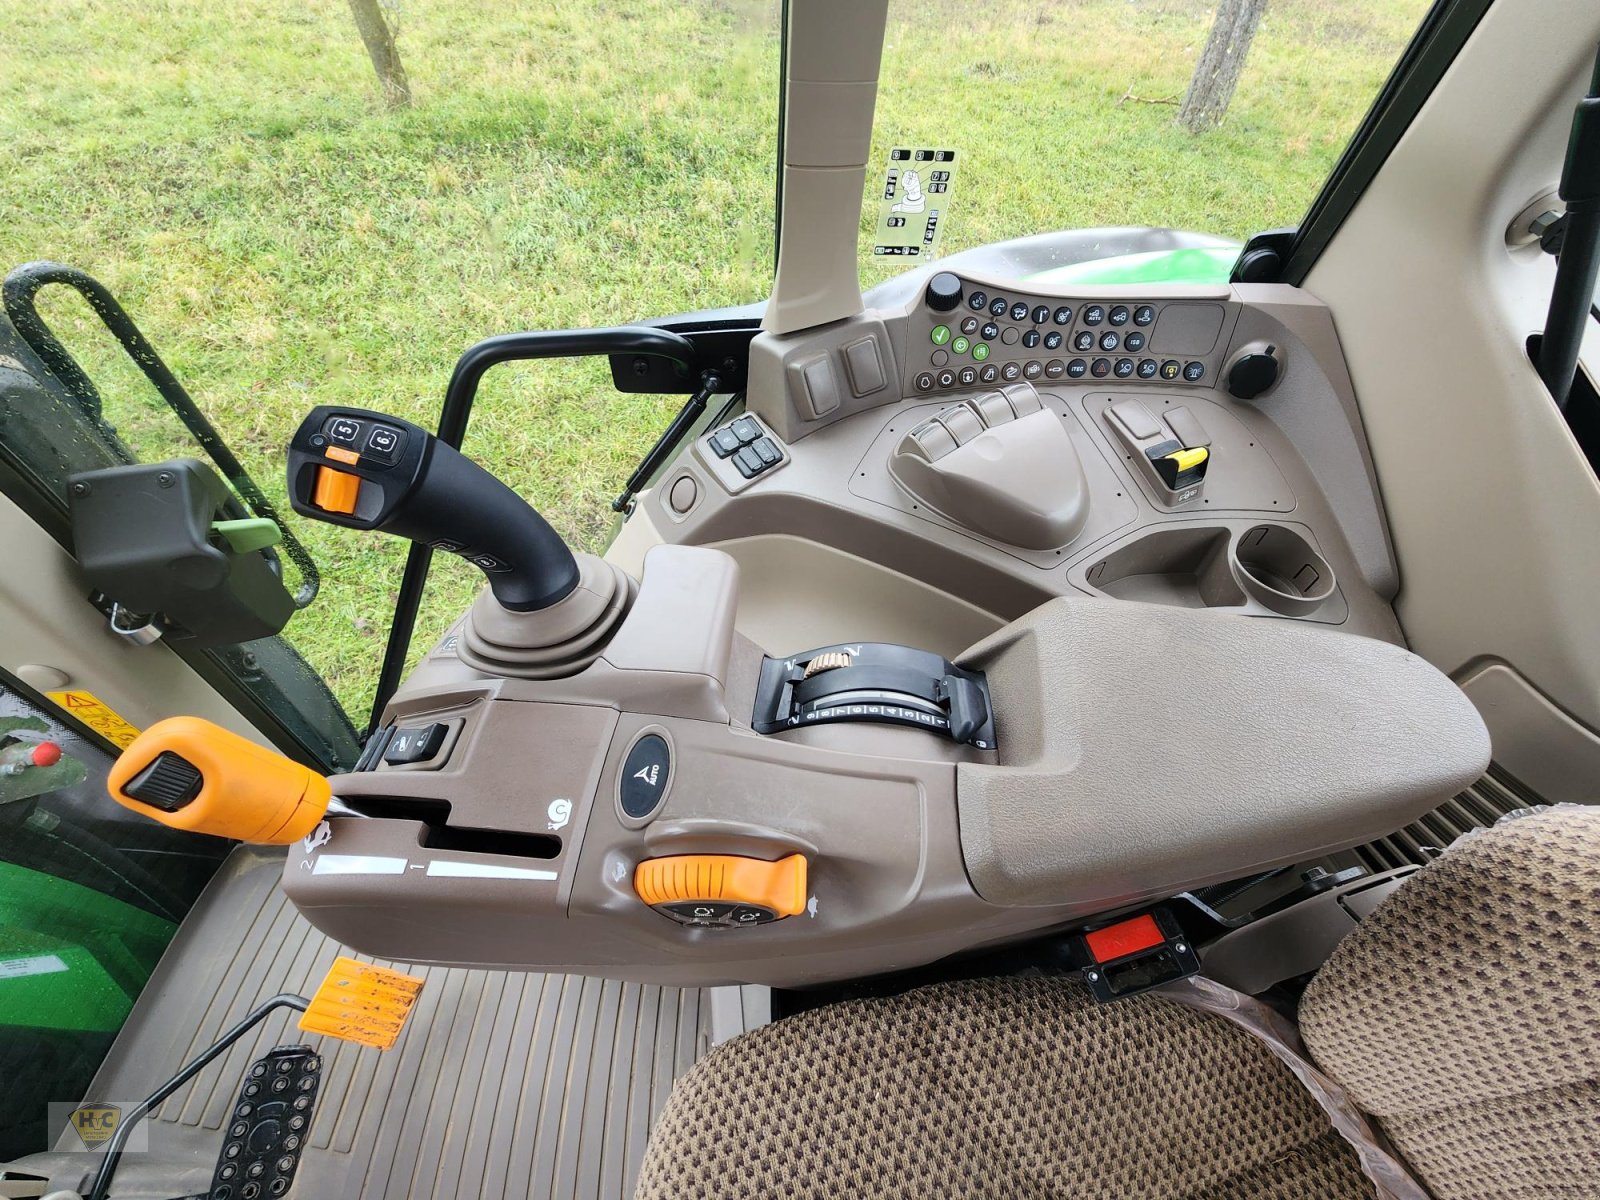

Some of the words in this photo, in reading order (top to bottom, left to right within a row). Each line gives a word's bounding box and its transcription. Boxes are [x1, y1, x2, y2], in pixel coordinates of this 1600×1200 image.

[338, 425, 352, 434] 5
[376, 436, 390, 445] 6
[904, 710, 915, 718] 3
[649, 764, 660, 786] AUTO
[300, 859, 315, 870] 2
